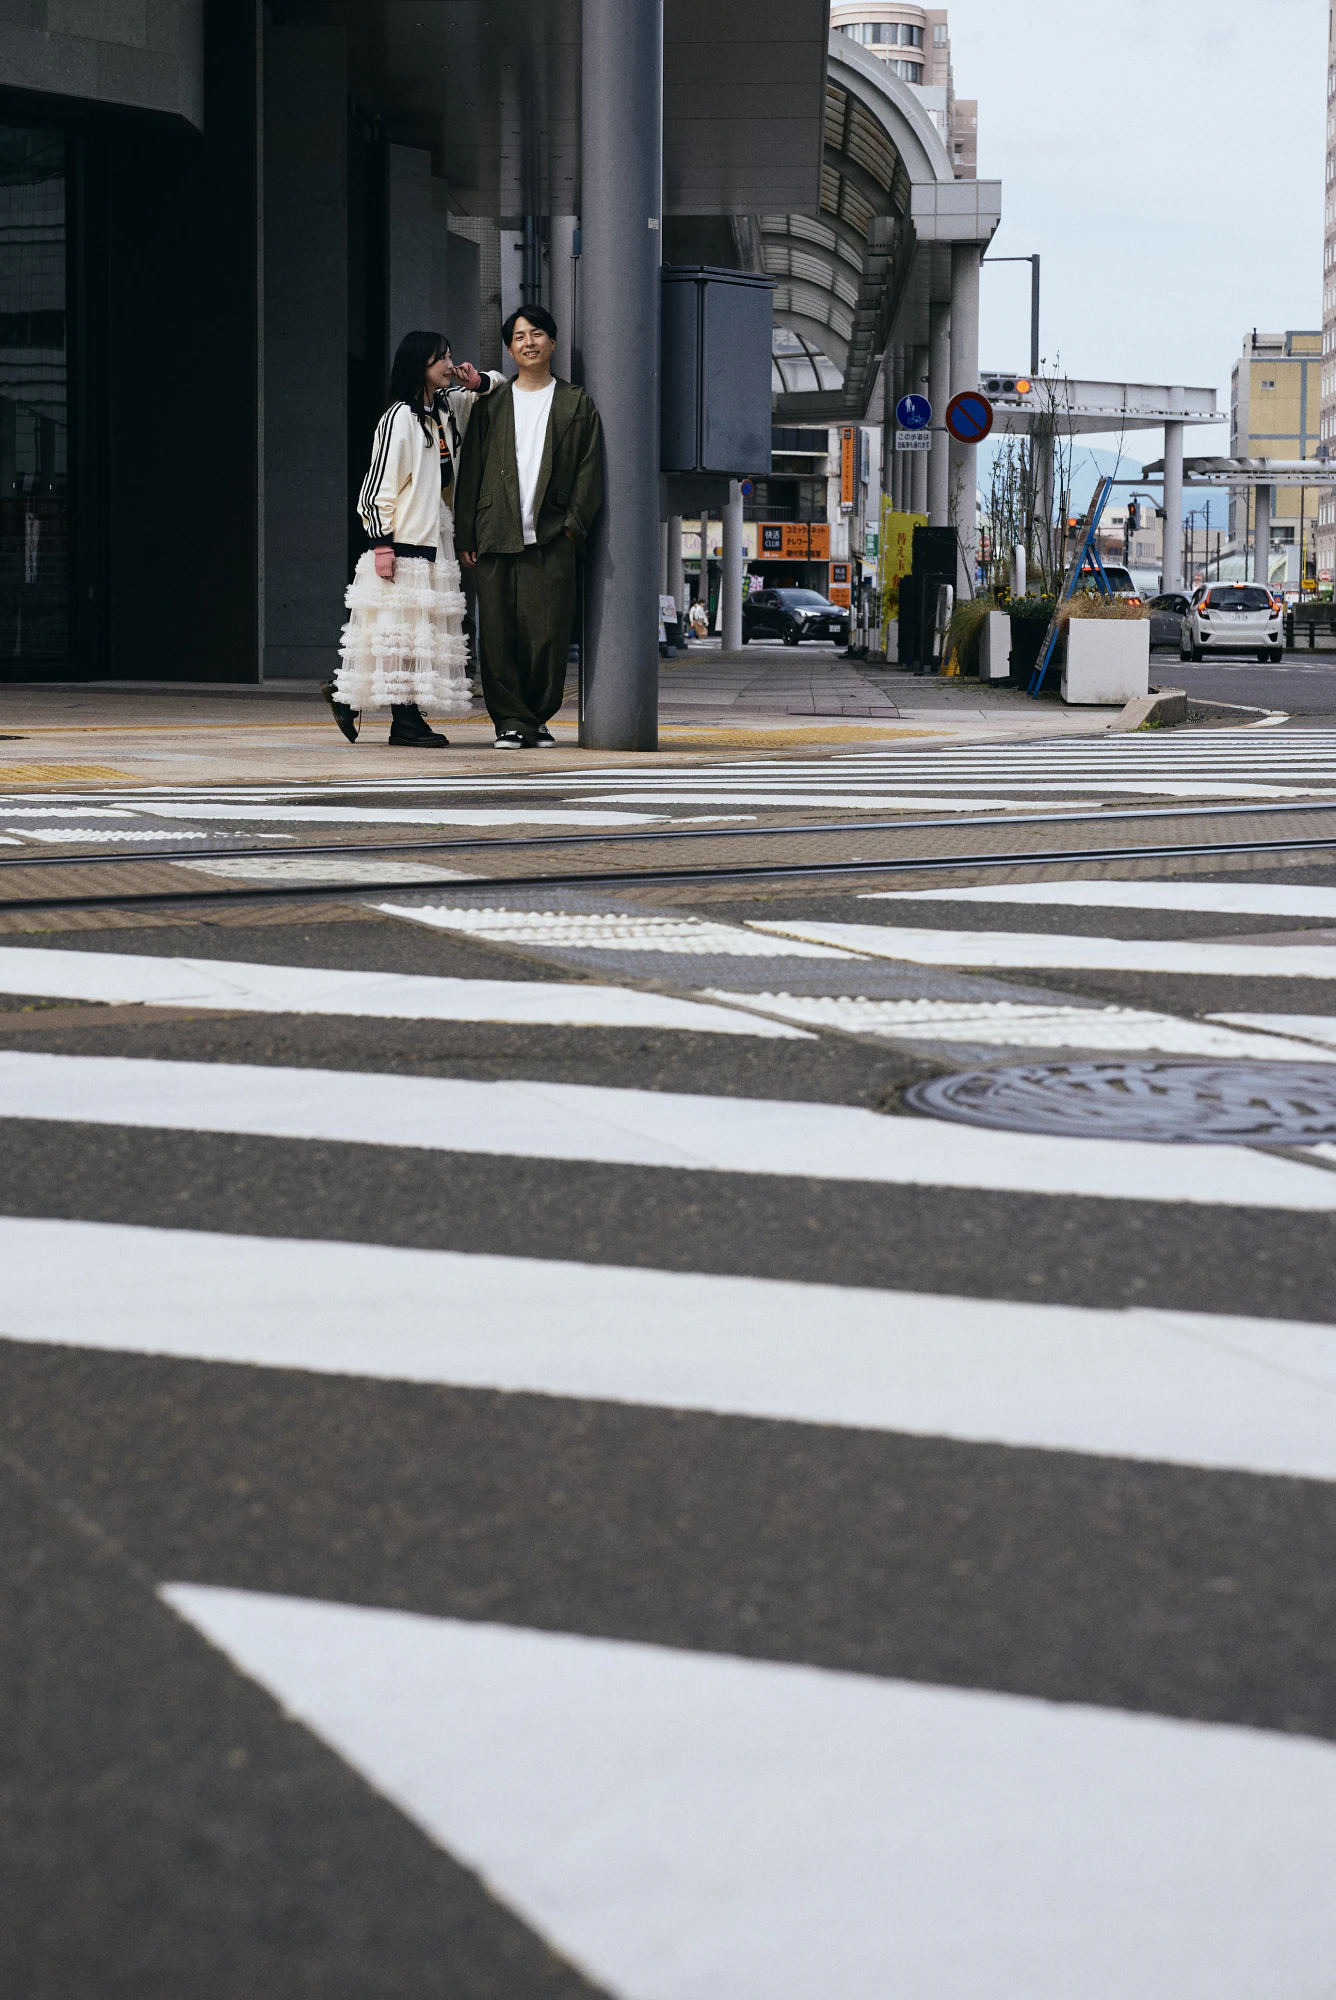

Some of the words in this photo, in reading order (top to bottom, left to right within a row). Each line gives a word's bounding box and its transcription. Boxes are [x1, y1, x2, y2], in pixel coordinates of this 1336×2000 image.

[898, 433, 930, 441] この歩道は
[897, 441, 930, 449] 自転車も通れます
